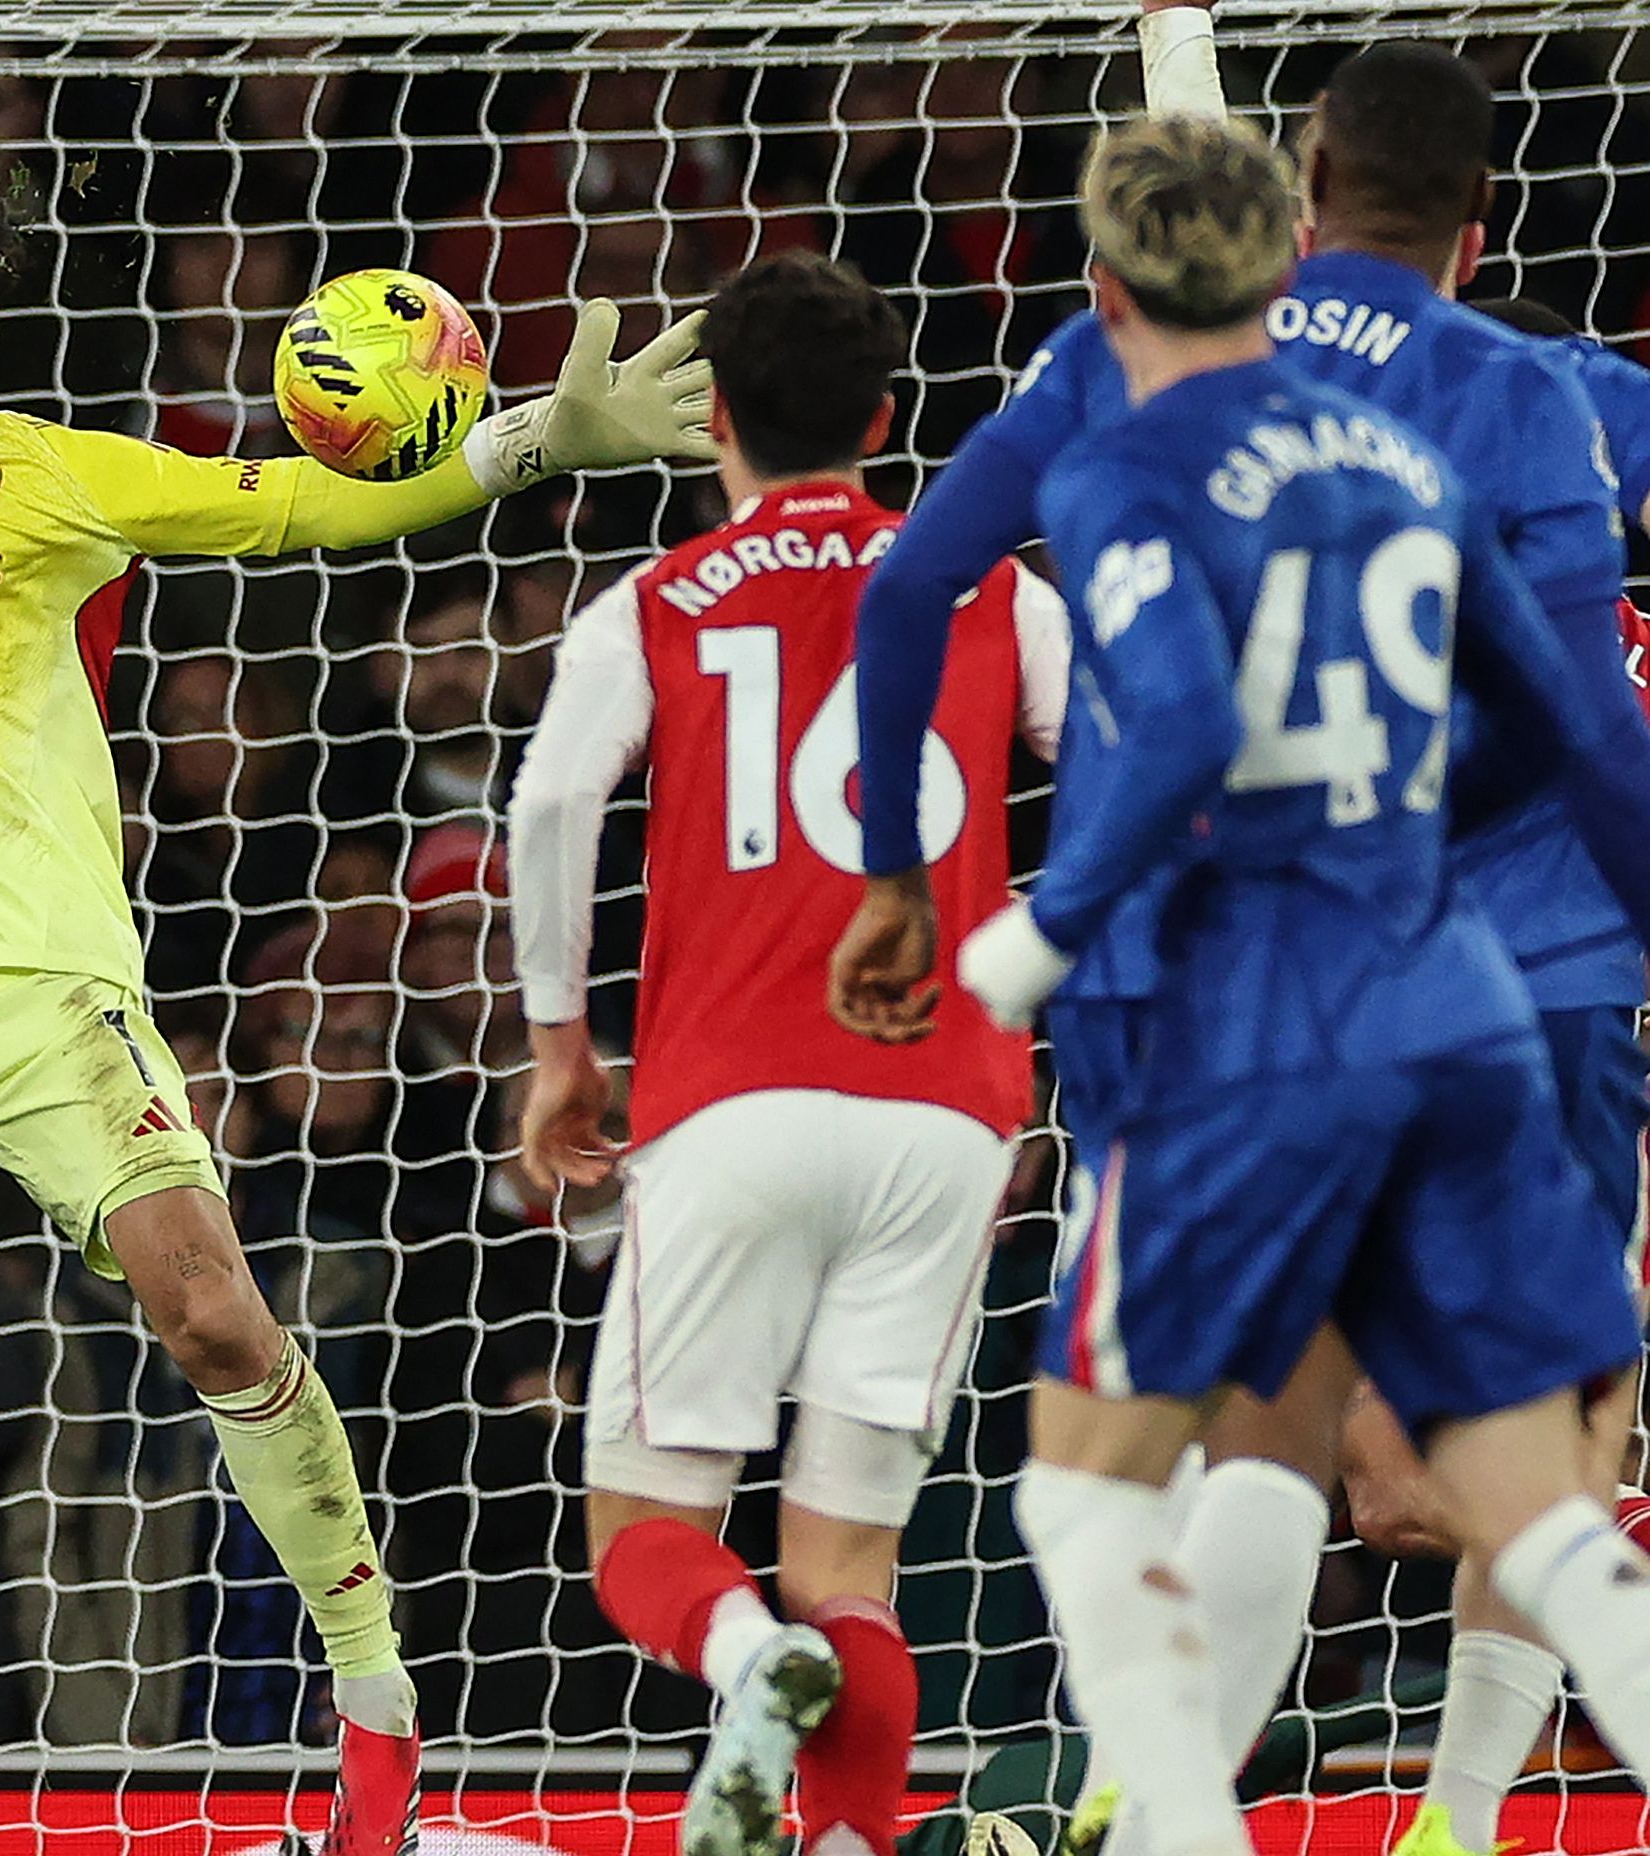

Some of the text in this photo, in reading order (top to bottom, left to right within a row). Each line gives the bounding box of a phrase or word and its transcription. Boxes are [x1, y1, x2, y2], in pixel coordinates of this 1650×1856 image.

[1265, 296, 1412, 367] OSIN
[696, 625, 968, 875] 16
[1222, 526, 1461, 828] 49
